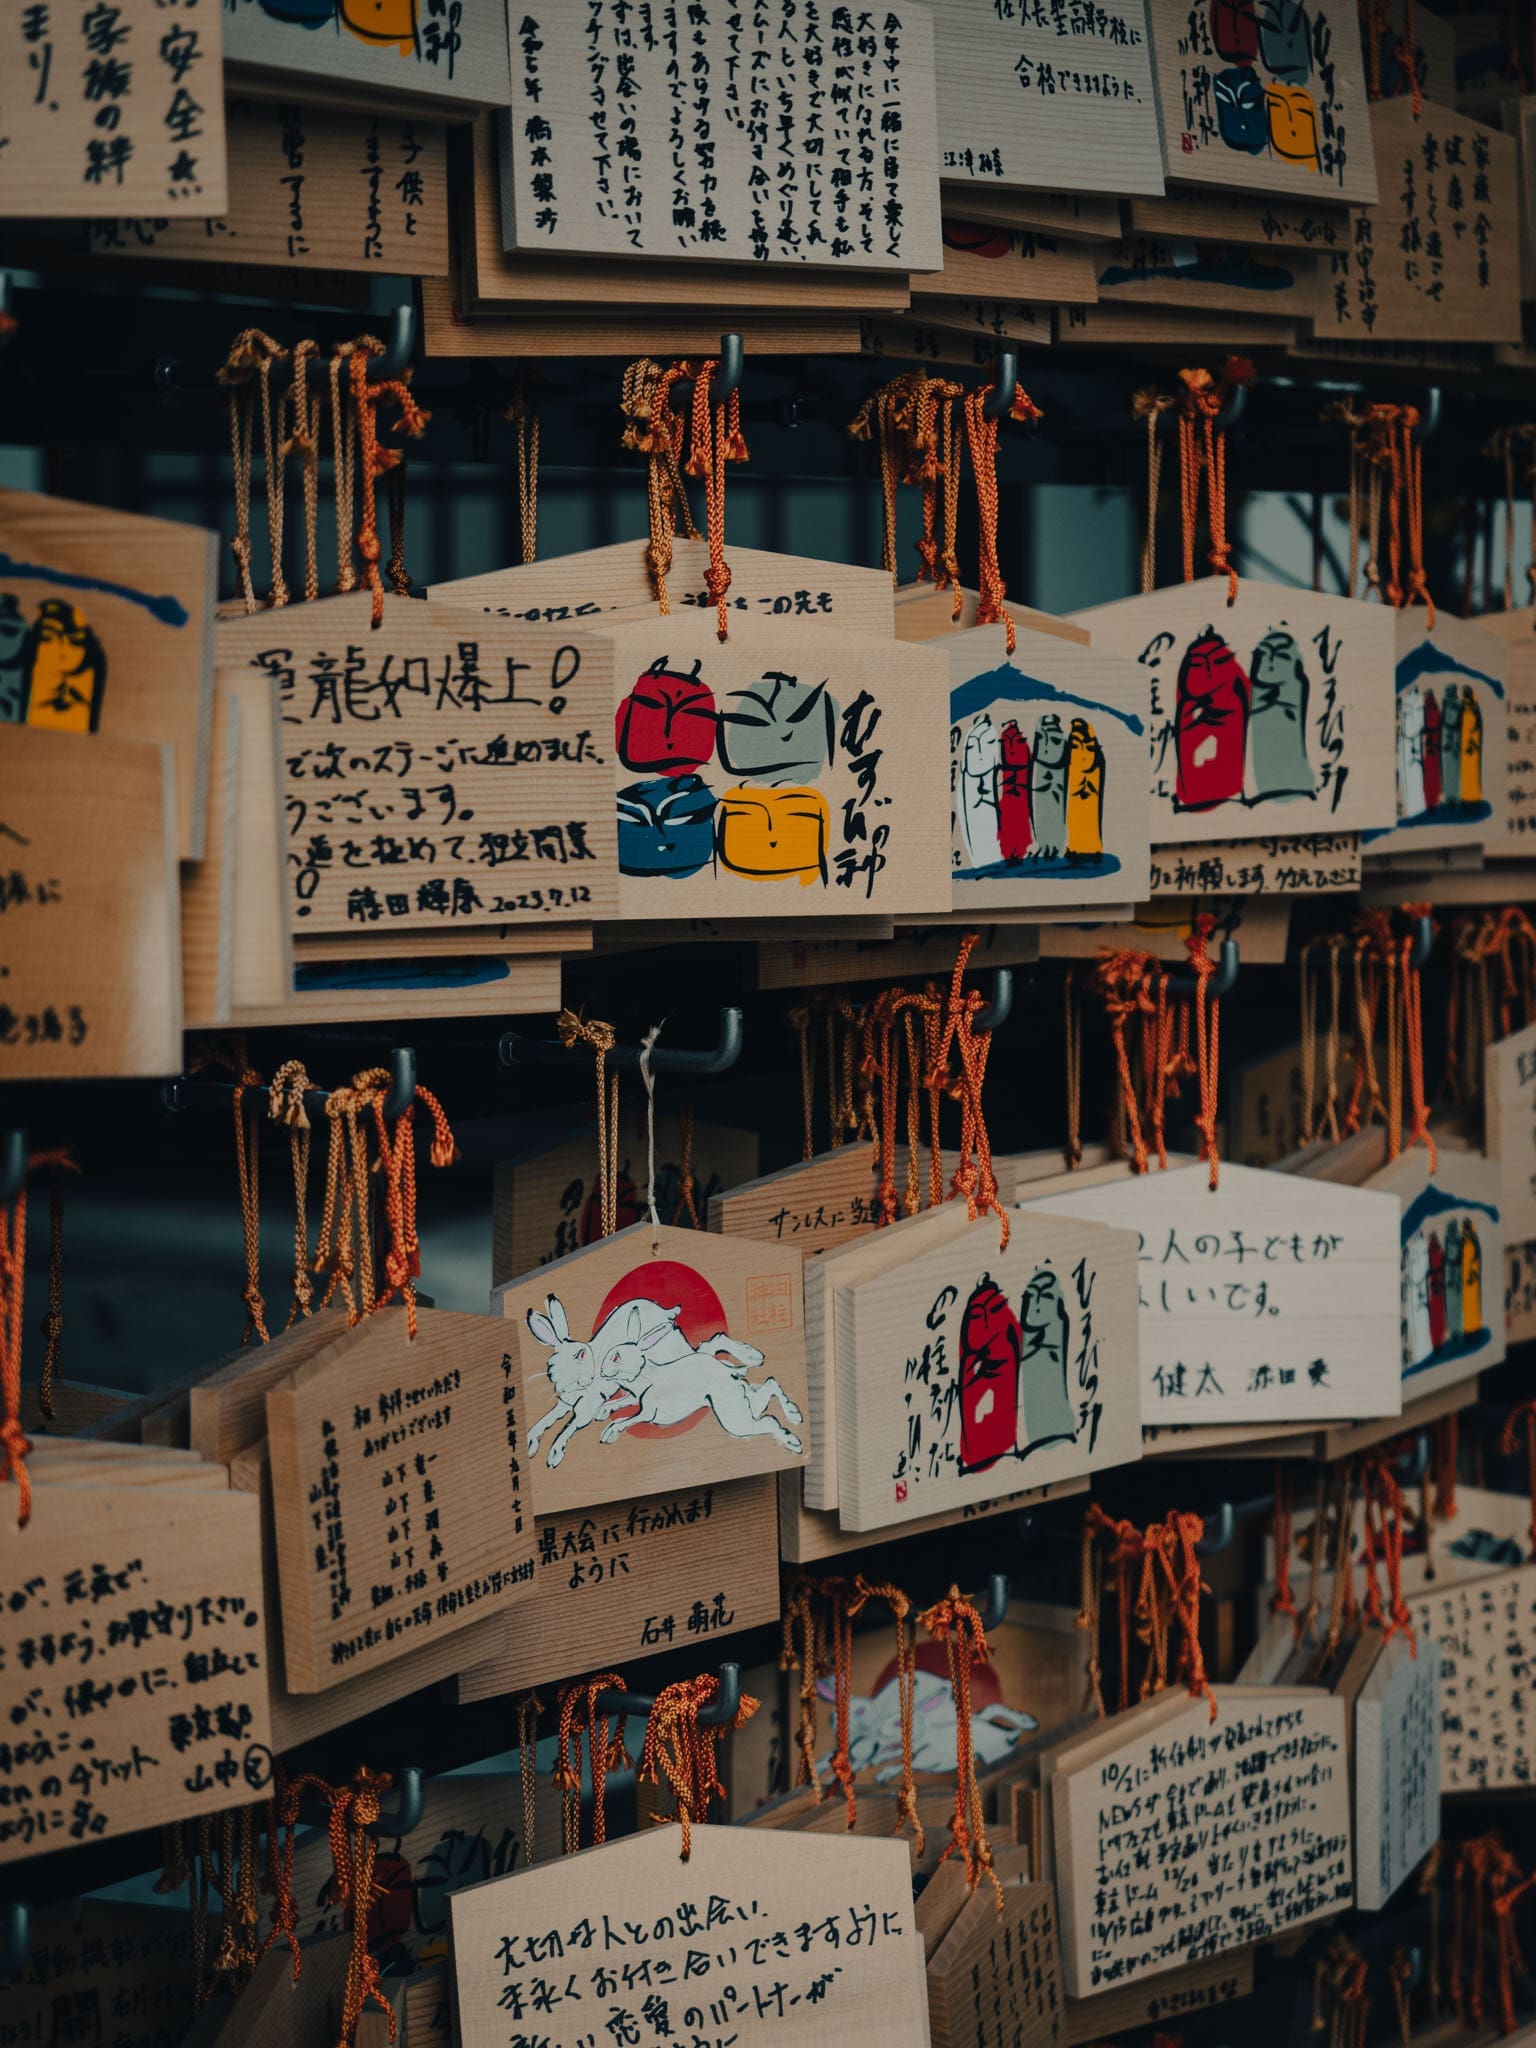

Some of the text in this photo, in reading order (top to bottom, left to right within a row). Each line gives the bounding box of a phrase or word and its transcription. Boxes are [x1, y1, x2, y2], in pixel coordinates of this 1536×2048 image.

[569, 1552, 630, 1590] ように
[640, 1614, 677, 1646] 石井
